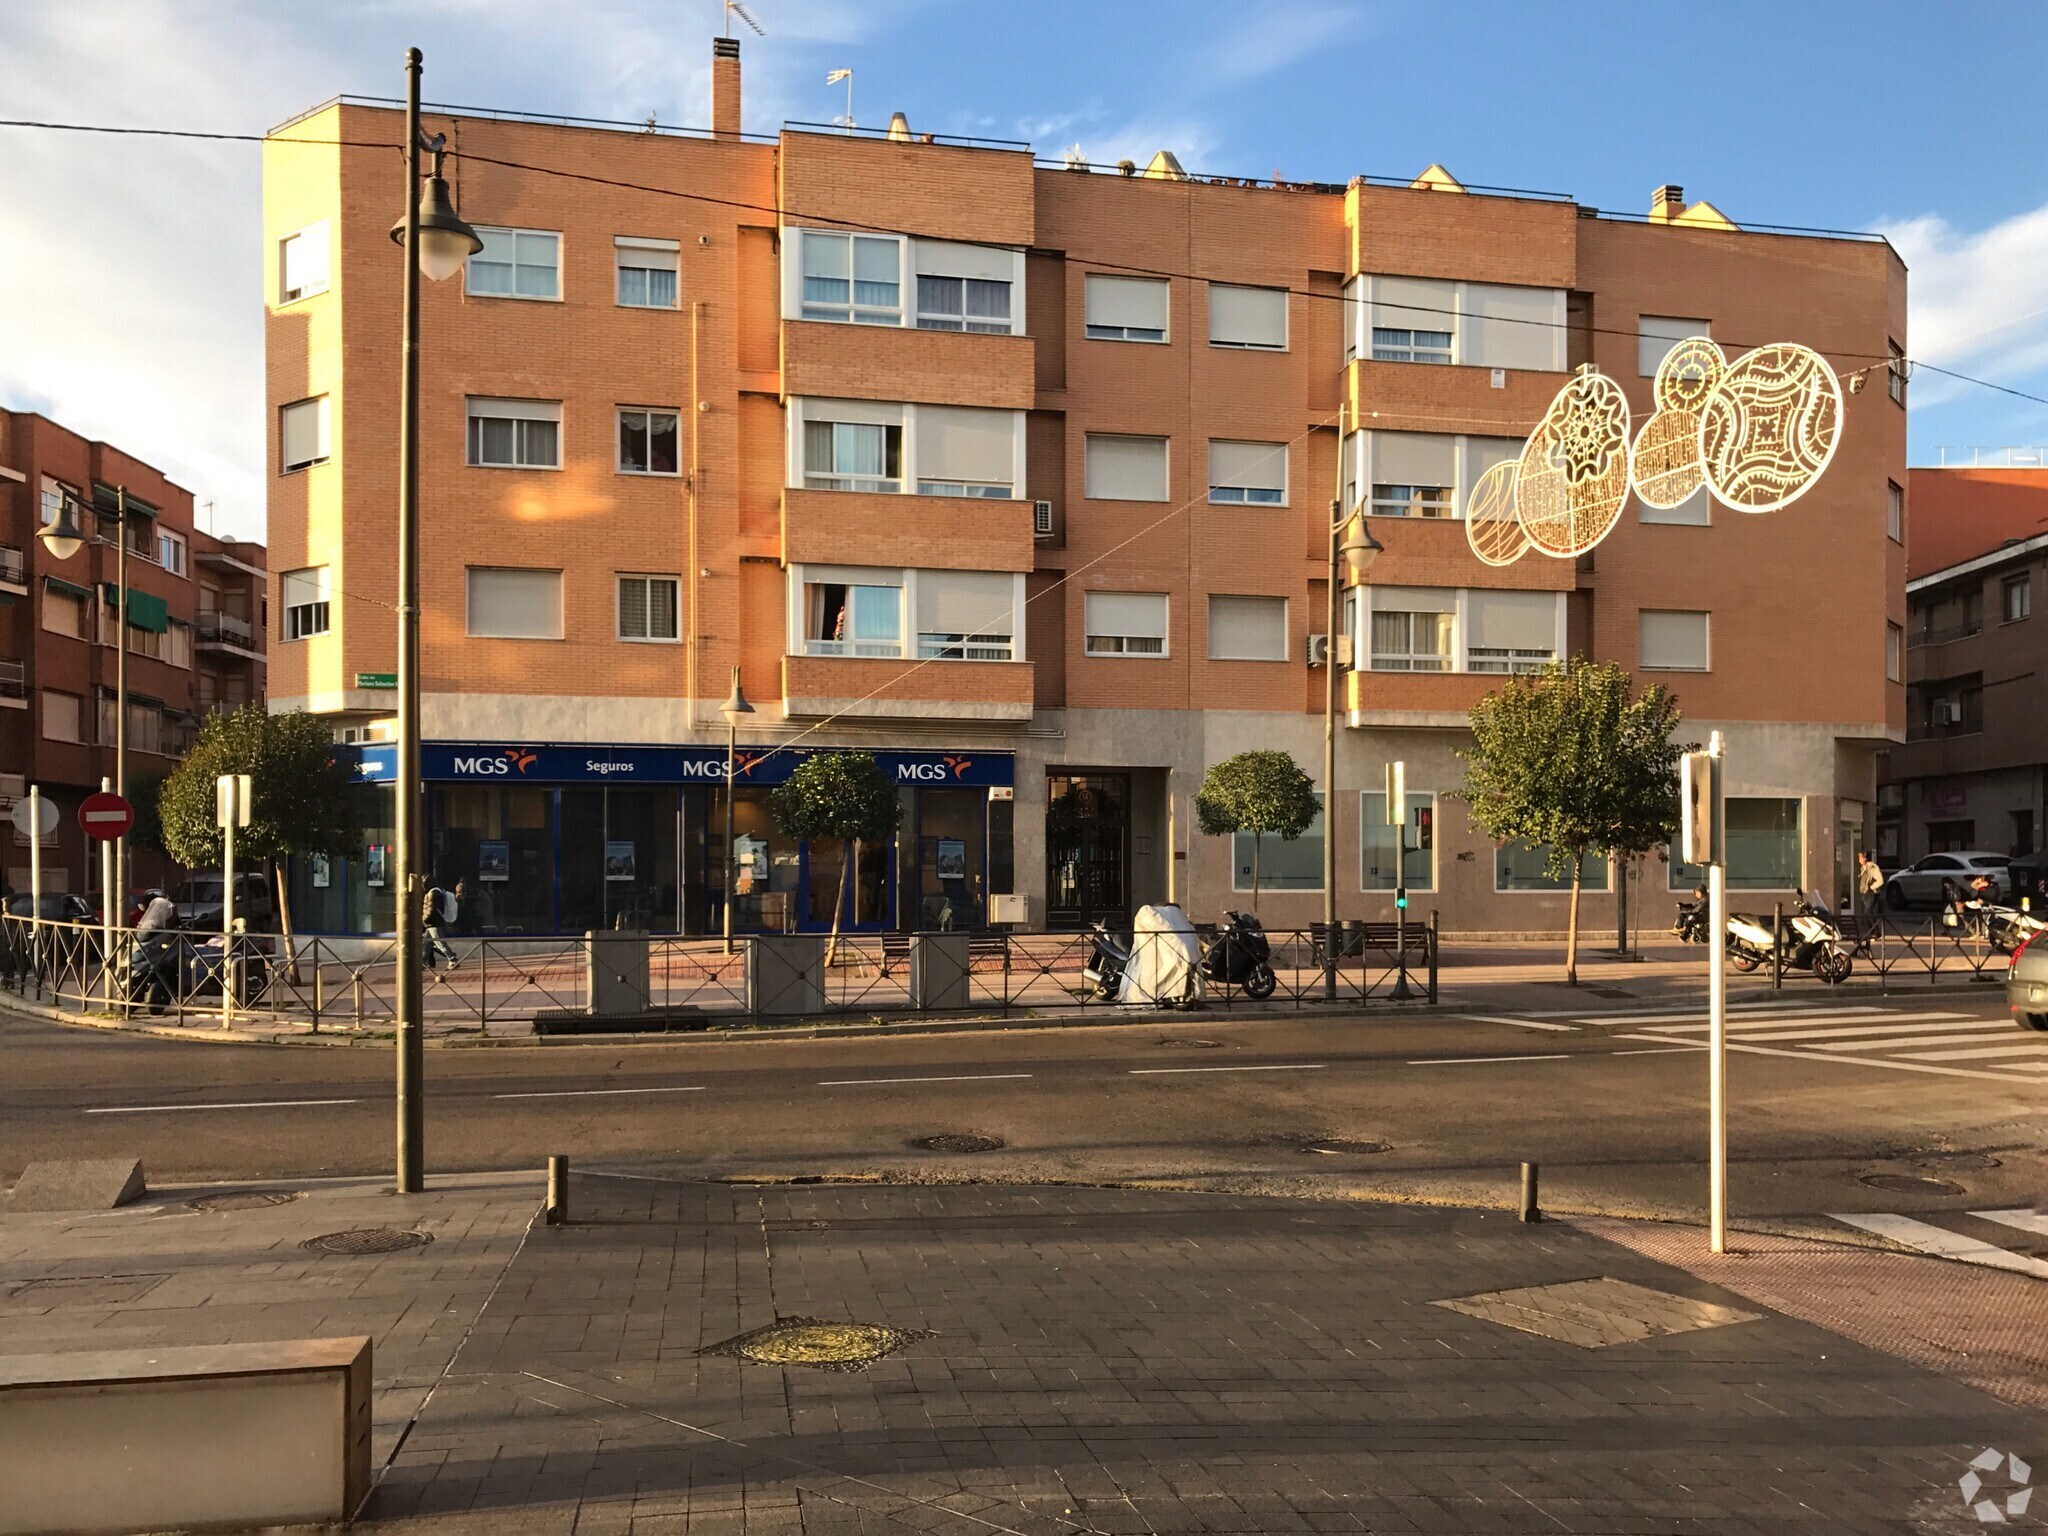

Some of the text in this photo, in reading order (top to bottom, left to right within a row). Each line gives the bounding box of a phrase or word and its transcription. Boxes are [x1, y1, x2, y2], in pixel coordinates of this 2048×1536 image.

[453, 757, 509, 775] MGS
[585, 760, 634, 775] Seguros
[683, 760, 731, 778] MGS
[898, 762, 946, 780] MGS
